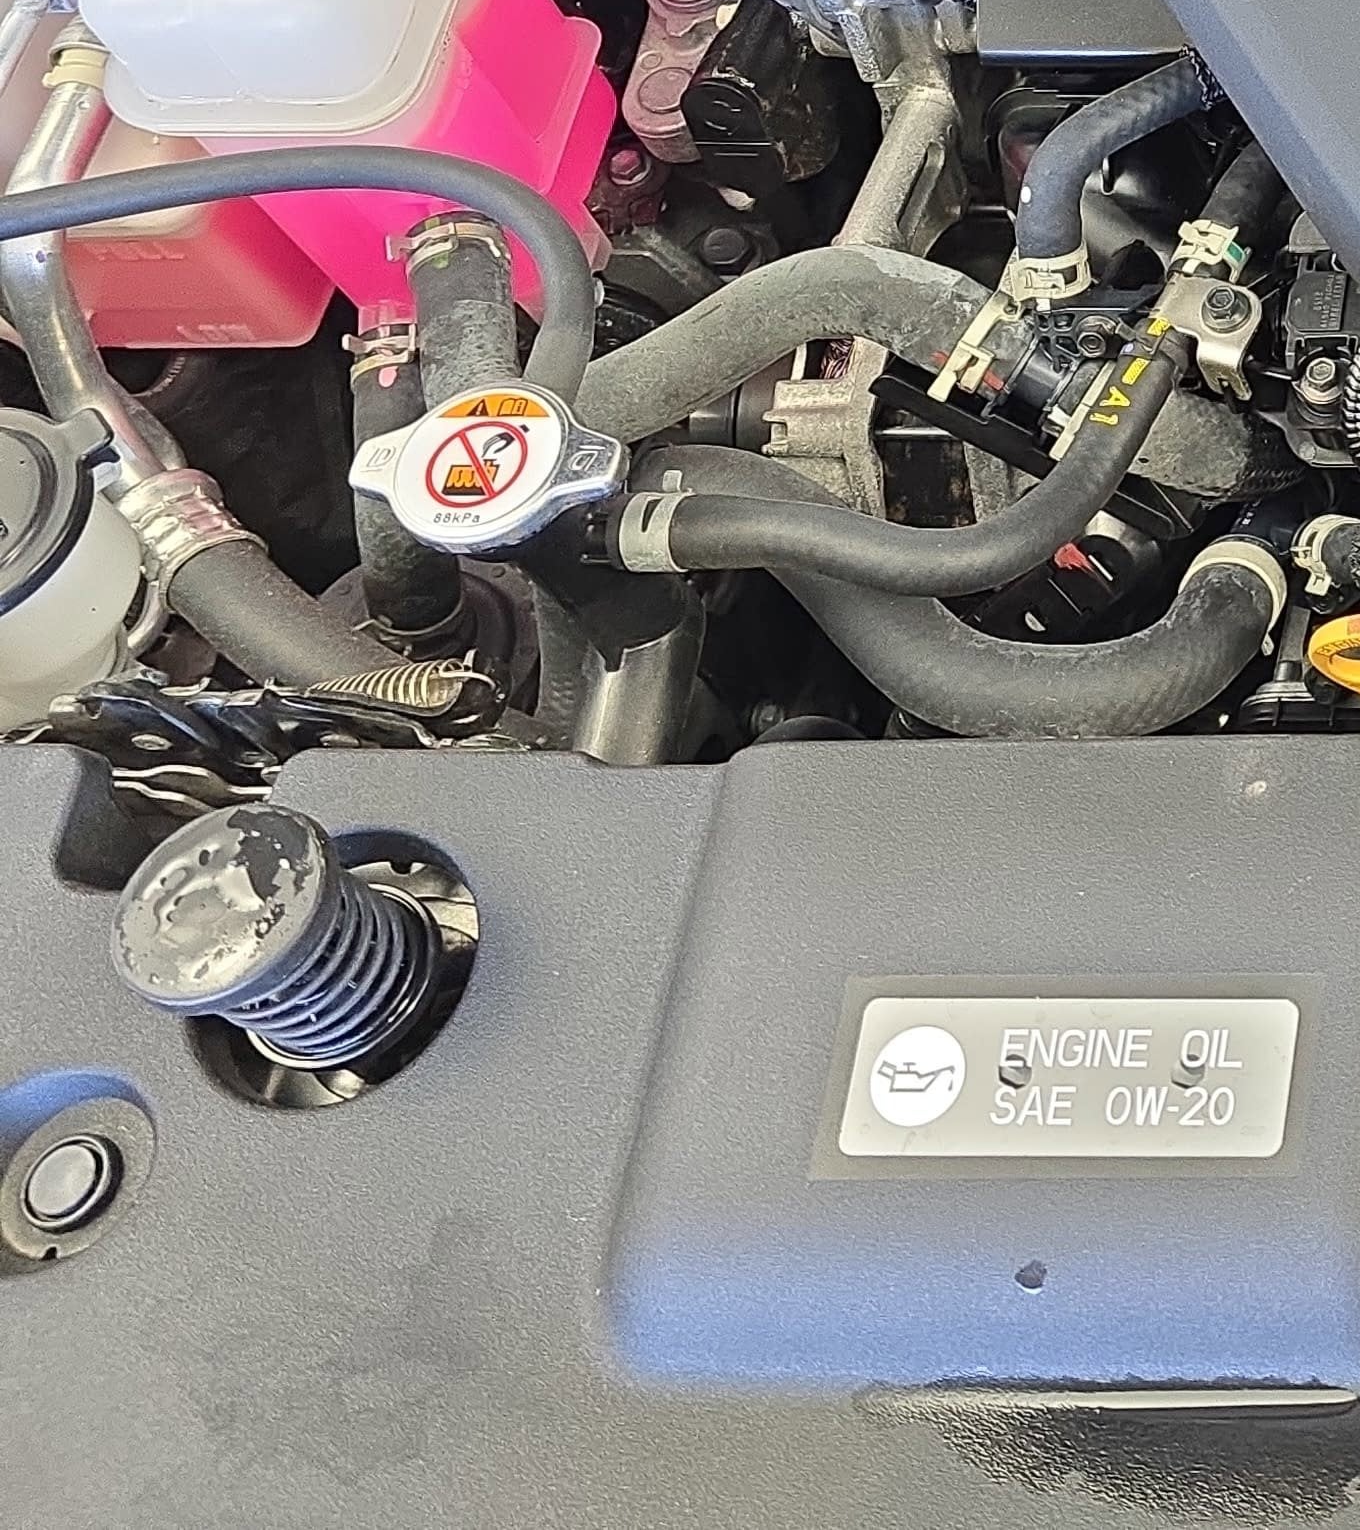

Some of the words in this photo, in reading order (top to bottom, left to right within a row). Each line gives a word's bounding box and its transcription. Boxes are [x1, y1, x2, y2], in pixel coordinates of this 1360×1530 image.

[1089, 386, 1131, 426] A1
[433, 511, 481, 525] 88kPa
[1000, 1028, 1153, 1070] ENGINE
[1180, 1028, 1243, 1070] OIL
[989, 1085, 1074, 1127] SAE
[1105, 1085, 1236, 1127] 0W-20
